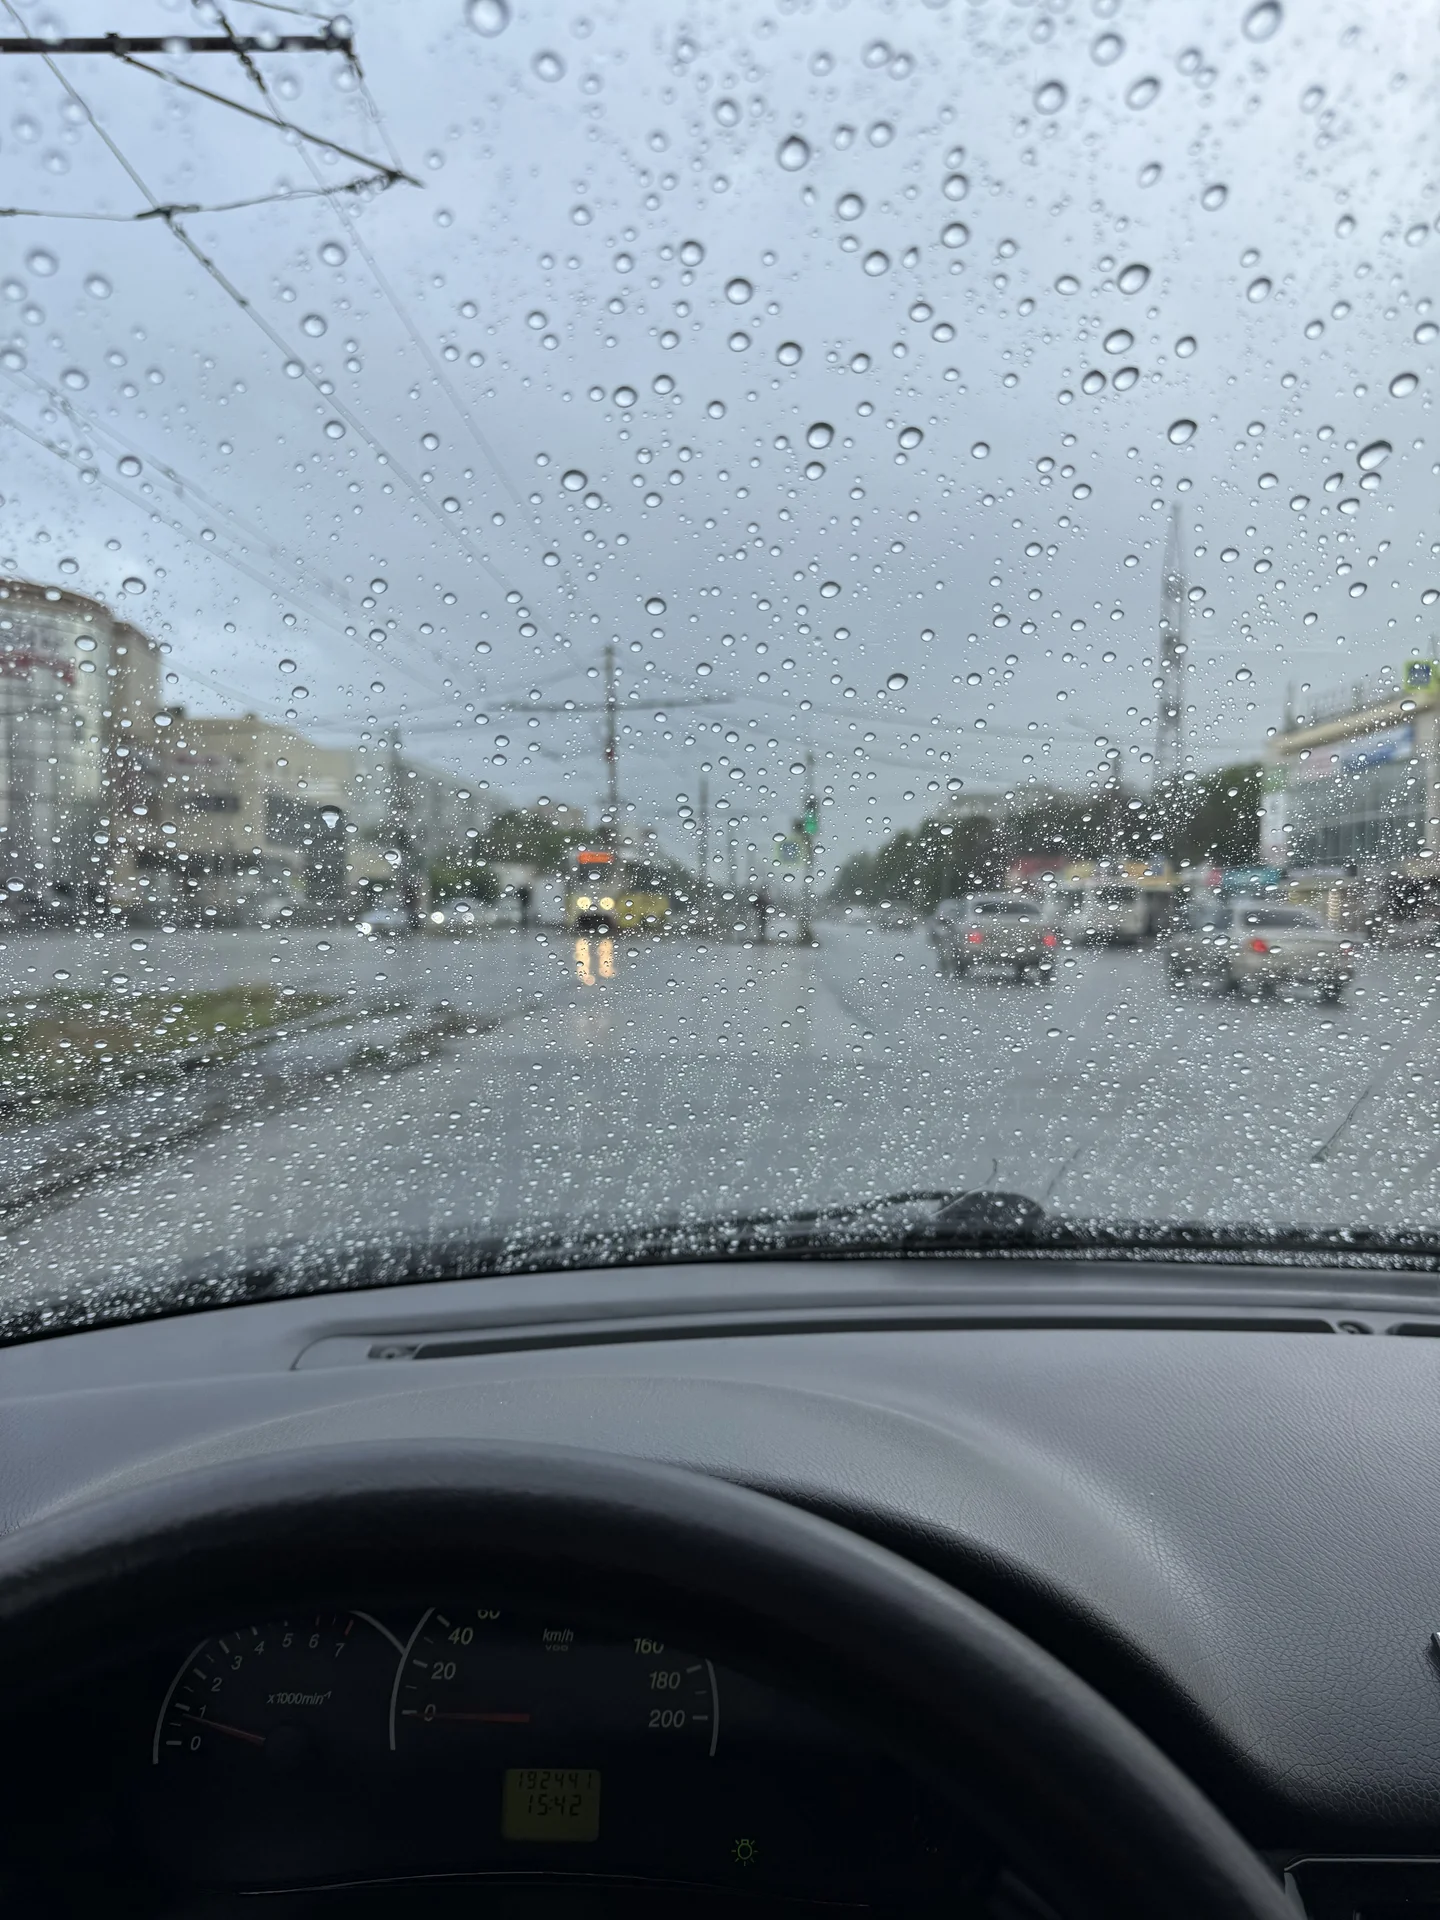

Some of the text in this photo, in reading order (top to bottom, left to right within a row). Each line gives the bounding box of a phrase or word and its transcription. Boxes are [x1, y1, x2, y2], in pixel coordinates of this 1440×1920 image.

[282, 1633, 294, 1647] 5
[309, 1633, 320, 1648] 6
[447, 1627, 474, 1645] 40
[542, 1628, 575, 1643] km/h
[254, 1641, 265, 1655] 4
[334, 1642, 346, 1657] 7
[231, 1655, 243, 1670] 3
[431, 1662, 456, 1680] 20
[211, 1677, 222, 1692] 2
[649, 1671, 681, 1690] 180
[199, 1705, 207, 1718] 1
[424, 1704, 436, 1722] 0
[648, 1709, 686, 1728] 200
[190, 1736, 202, 1751] 0
[518, 1771, 592, 1790] 192441
[528, 1794, 582, 1816] 15:42
